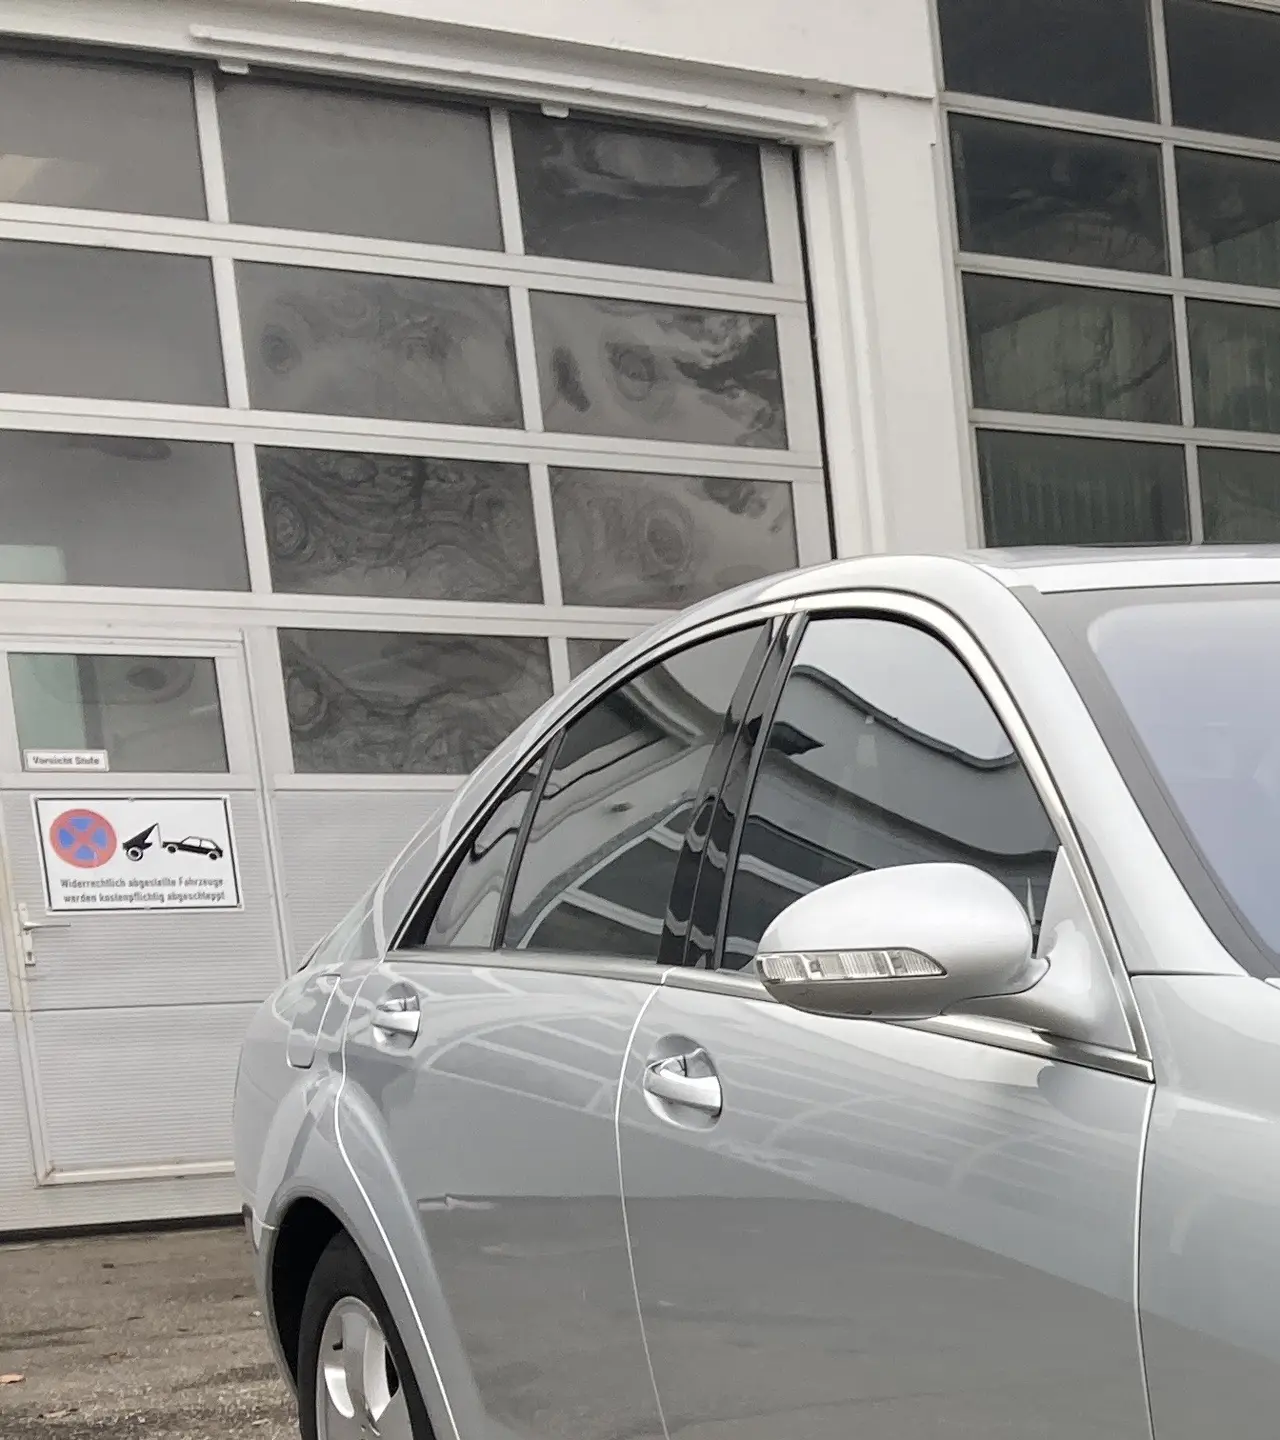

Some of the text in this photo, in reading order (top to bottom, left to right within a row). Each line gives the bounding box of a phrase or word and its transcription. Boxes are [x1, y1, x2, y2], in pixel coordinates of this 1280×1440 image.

[32, 756, 73, 765] Vorsicht
[60, 877, 223, 890] Widerrechtlich abgestellte Fahrzeuge
[64, 891, 225, 903] werden kostenpflichtig abgeschleppt
